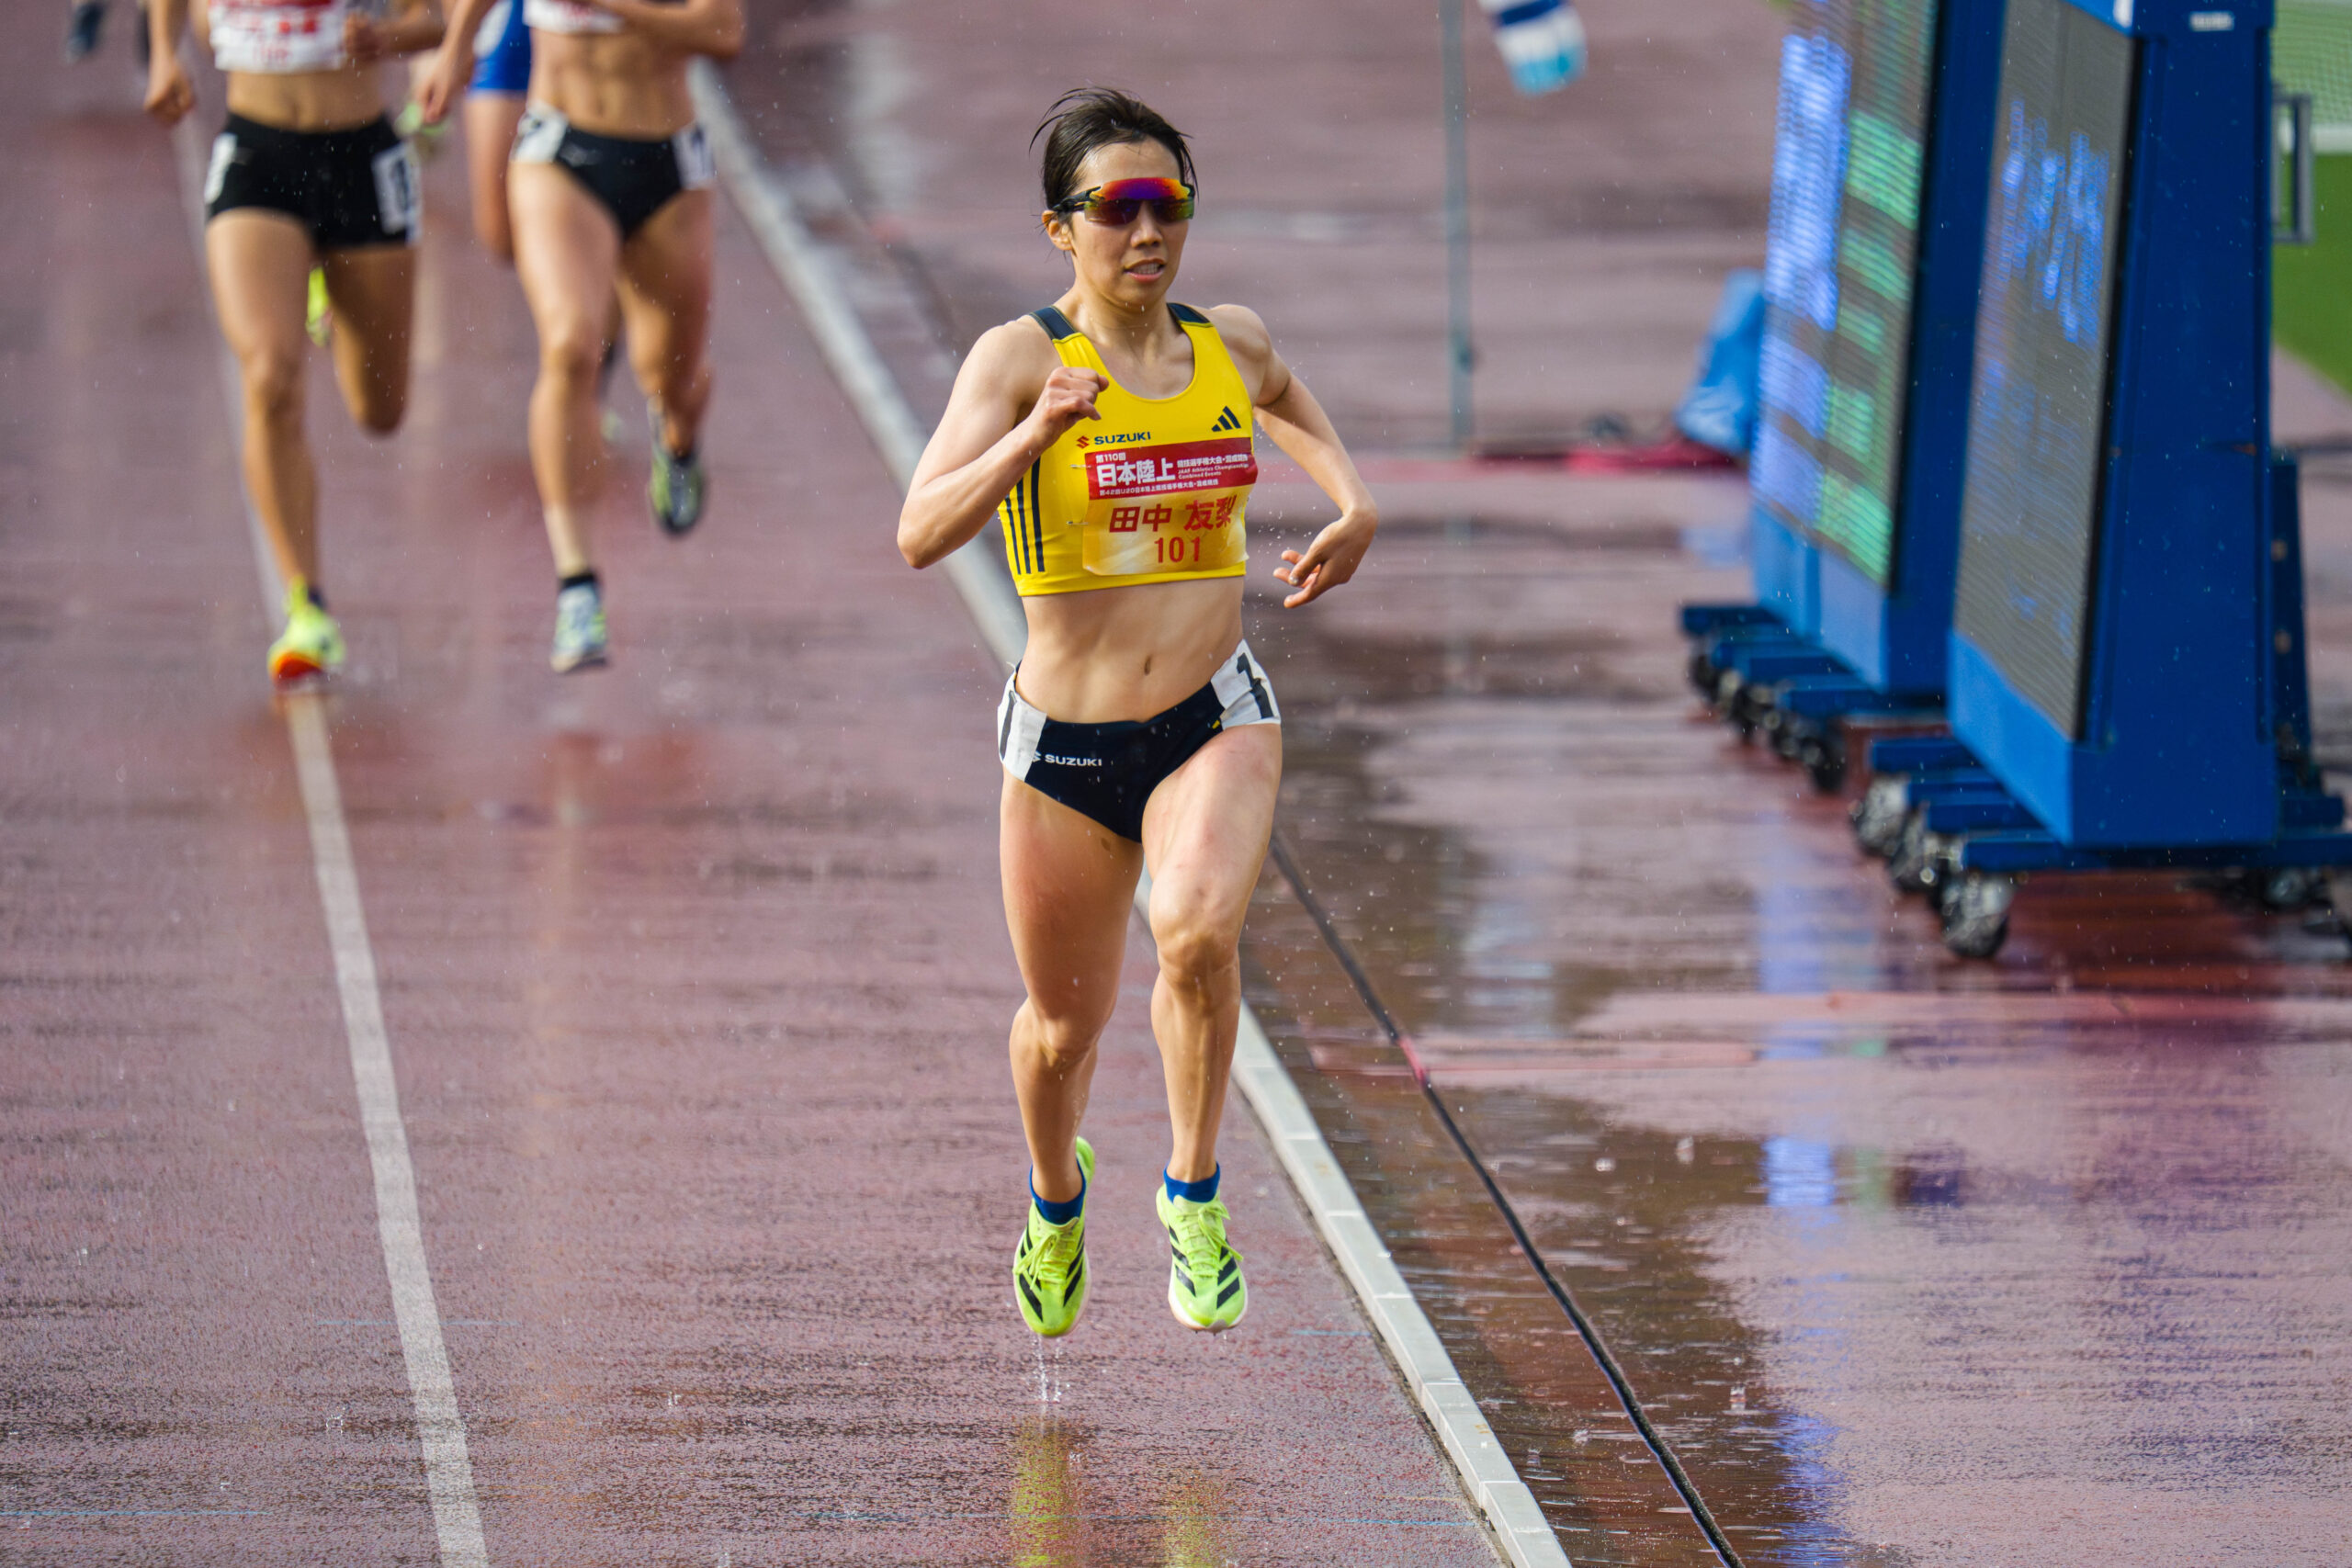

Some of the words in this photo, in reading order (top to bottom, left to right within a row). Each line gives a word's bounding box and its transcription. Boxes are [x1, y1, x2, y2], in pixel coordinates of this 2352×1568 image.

[1094, 432, 1151, 446] SUZUKI
[1097, 457, 1176, 488] 日本陸上
[1109, 503, 1172, 533] 田中
[1154, 536, 1201, 563] 101
[1237, 652, 1274, 719] 1
[1045, 753, 1102, 766] SUZUKI
